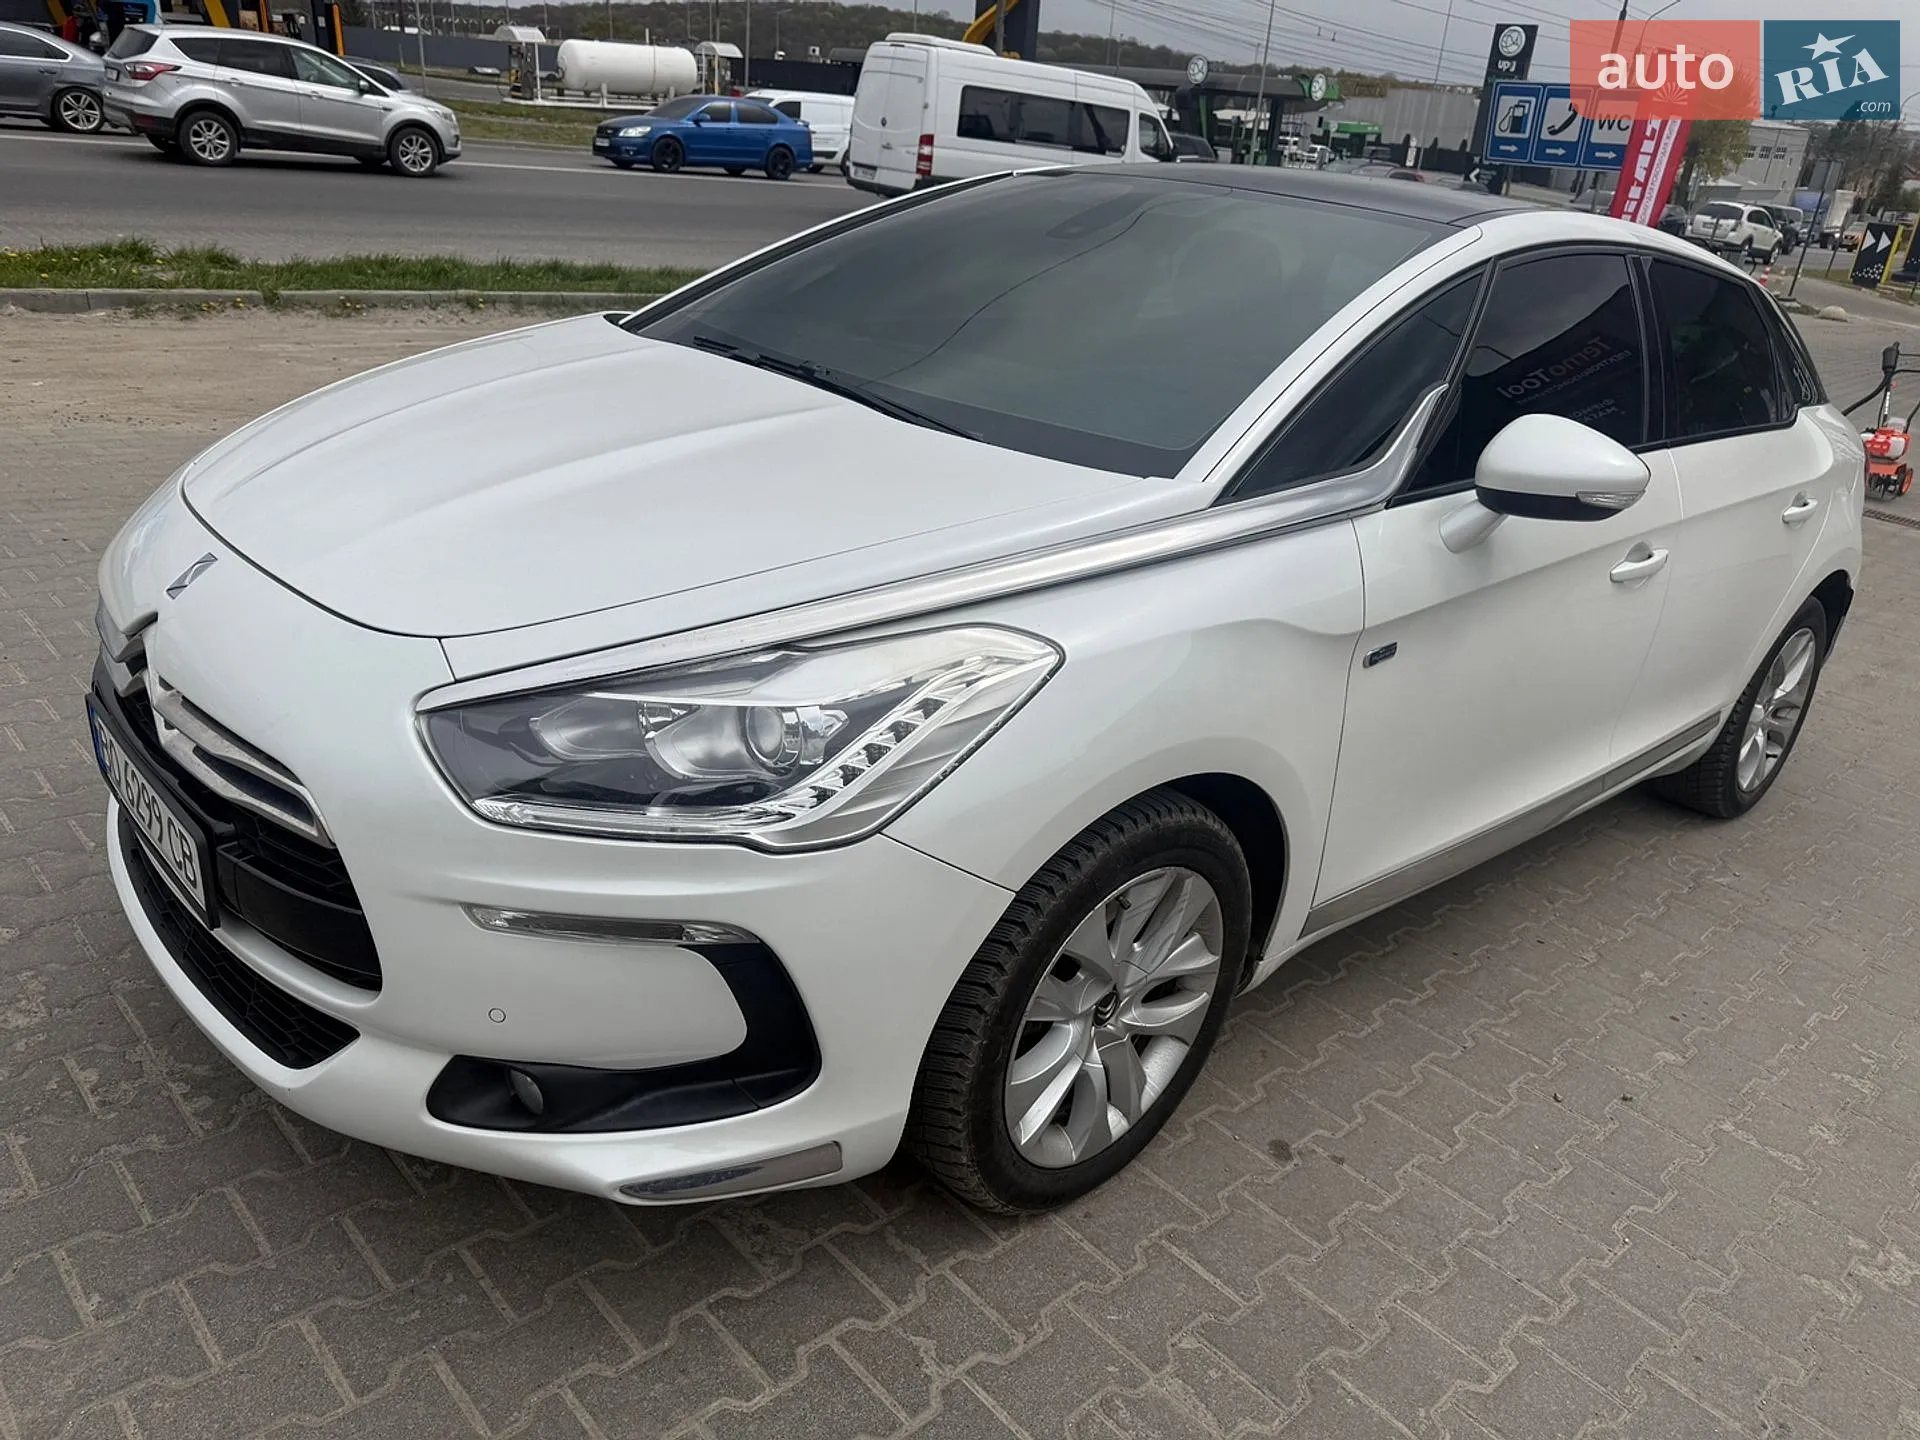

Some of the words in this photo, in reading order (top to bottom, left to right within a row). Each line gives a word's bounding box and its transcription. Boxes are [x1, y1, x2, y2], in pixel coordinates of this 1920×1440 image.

[1599, 114, 1631, 131] WC
[124, 760, 163, 844] 6299
[168, 816, 197, 889] CB
